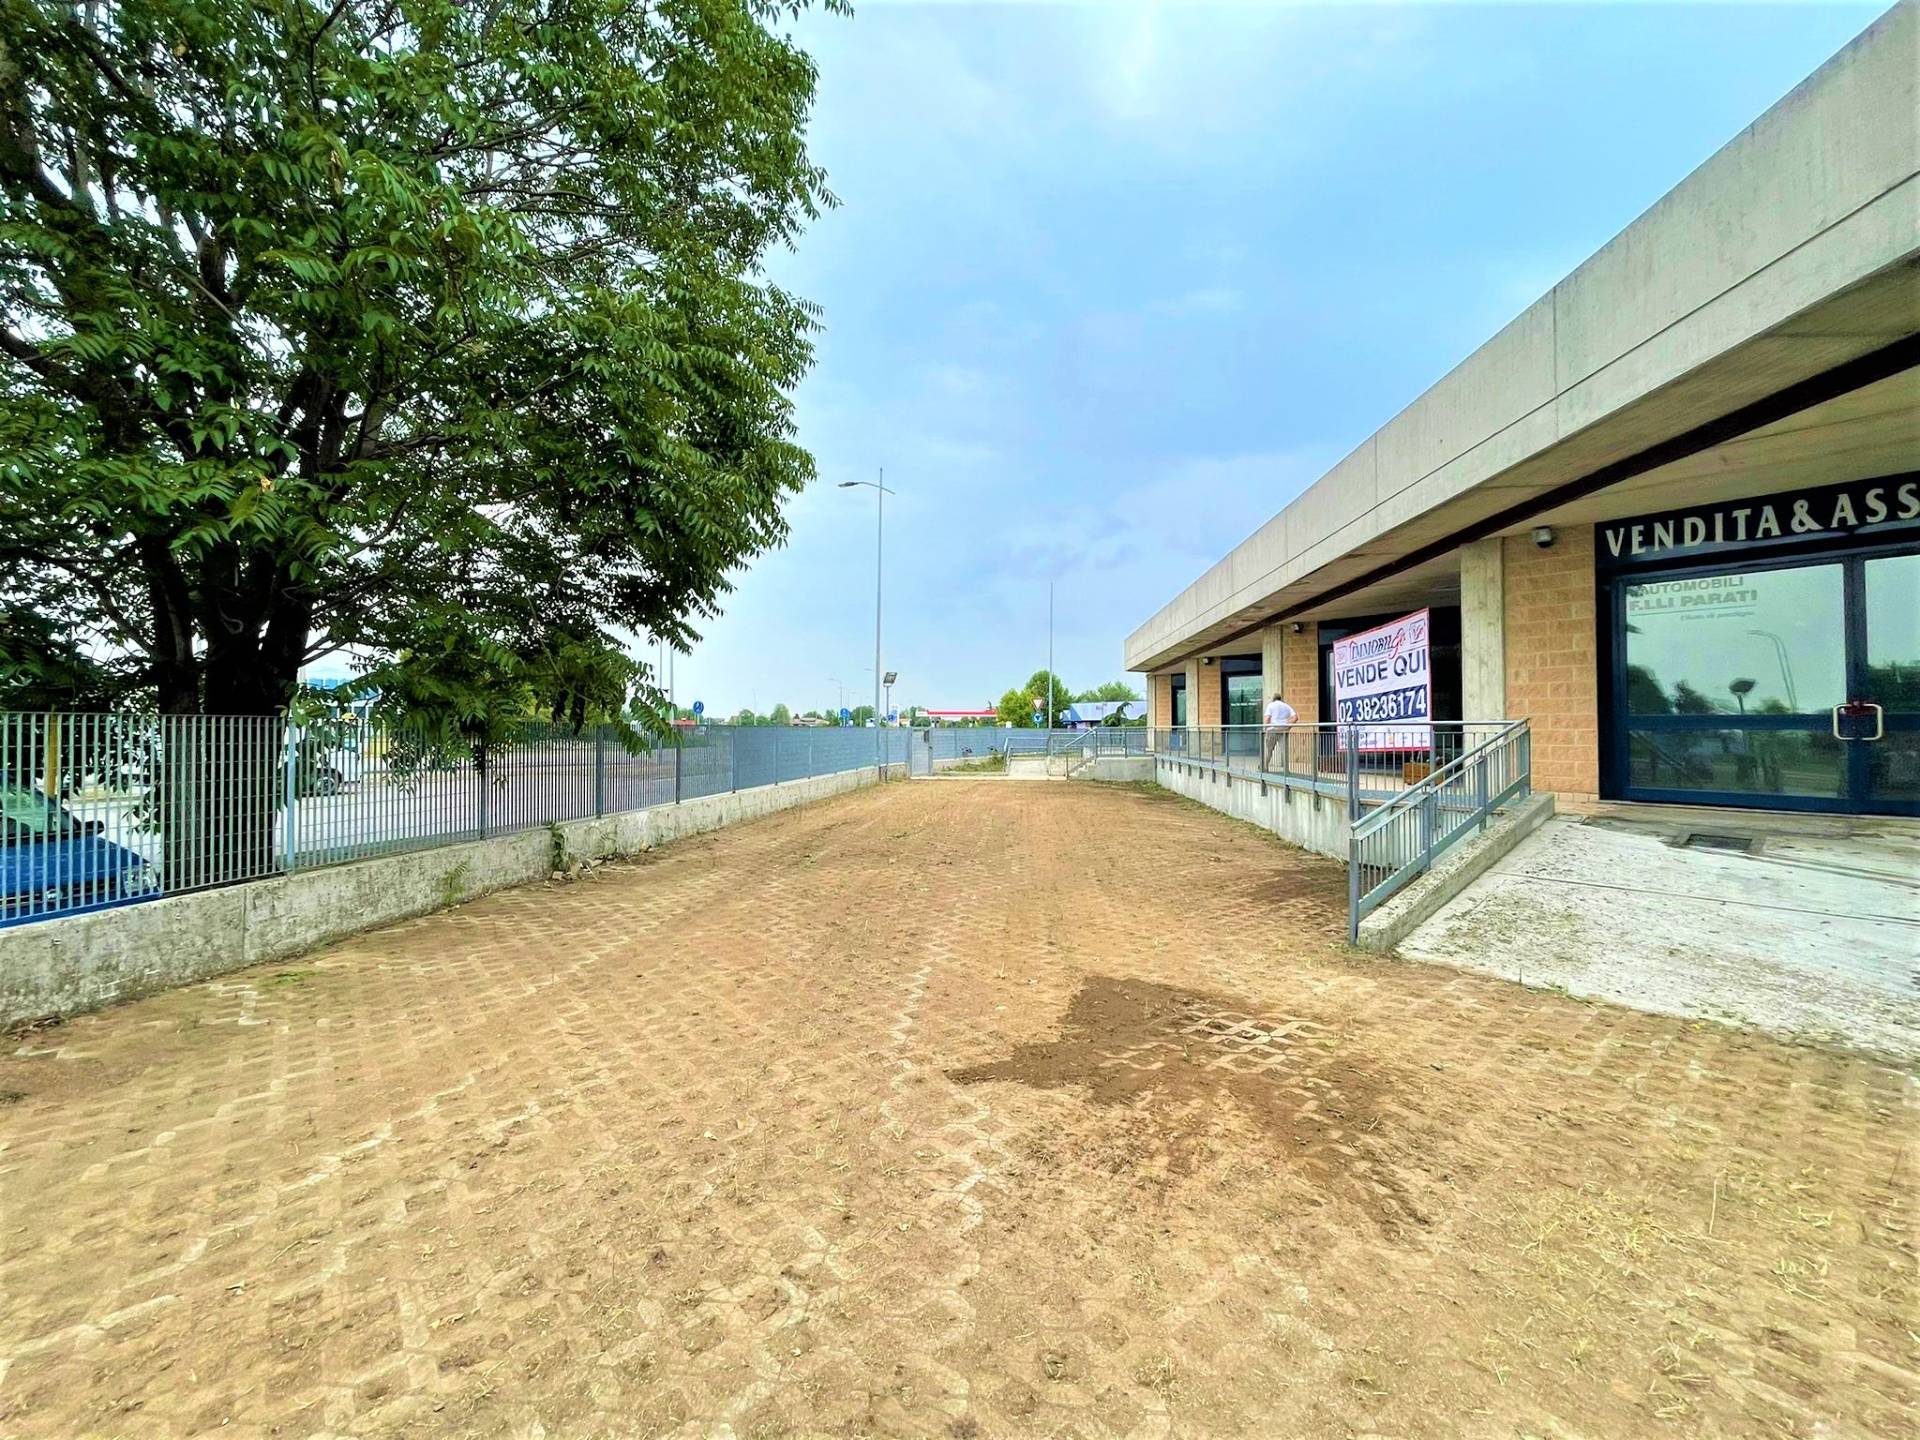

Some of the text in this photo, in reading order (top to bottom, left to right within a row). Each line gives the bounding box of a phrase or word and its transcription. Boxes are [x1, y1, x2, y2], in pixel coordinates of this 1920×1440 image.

[1680, 589, 1758, 607] PARATI
[1337, 649, 1426, 688] VENDE QUI
[1339, 689, 1426, 723] 02 38236174
